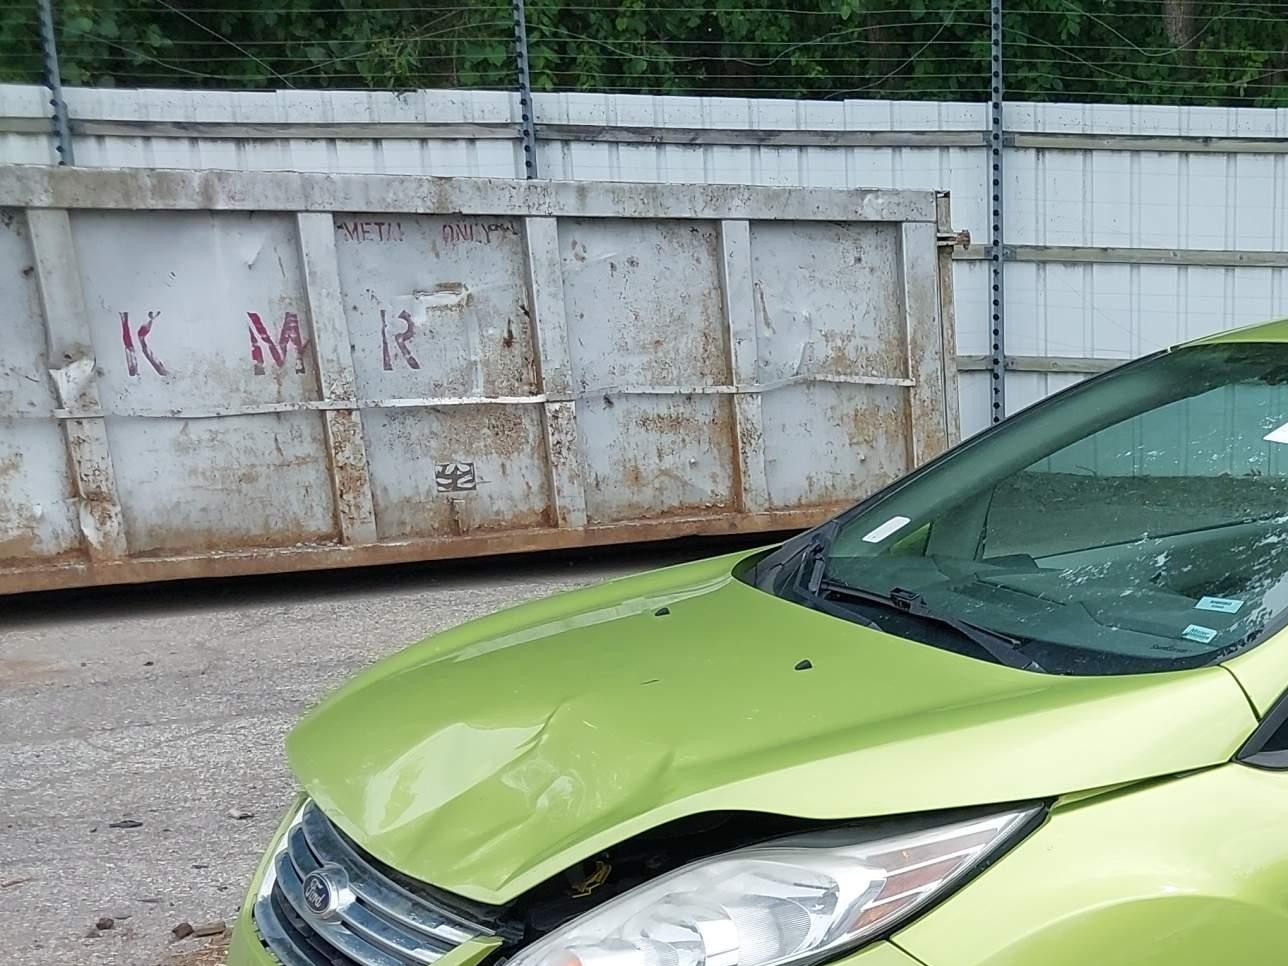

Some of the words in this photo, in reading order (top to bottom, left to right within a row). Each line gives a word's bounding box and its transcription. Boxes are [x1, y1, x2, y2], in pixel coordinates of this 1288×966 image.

[442, 223, 497, 244] ONLY
[118, 311, 168, 376] K
[246, 311, 309, 376] M
[379, 310, 421, 371] R
[306, 879, 325, 907] Ford
